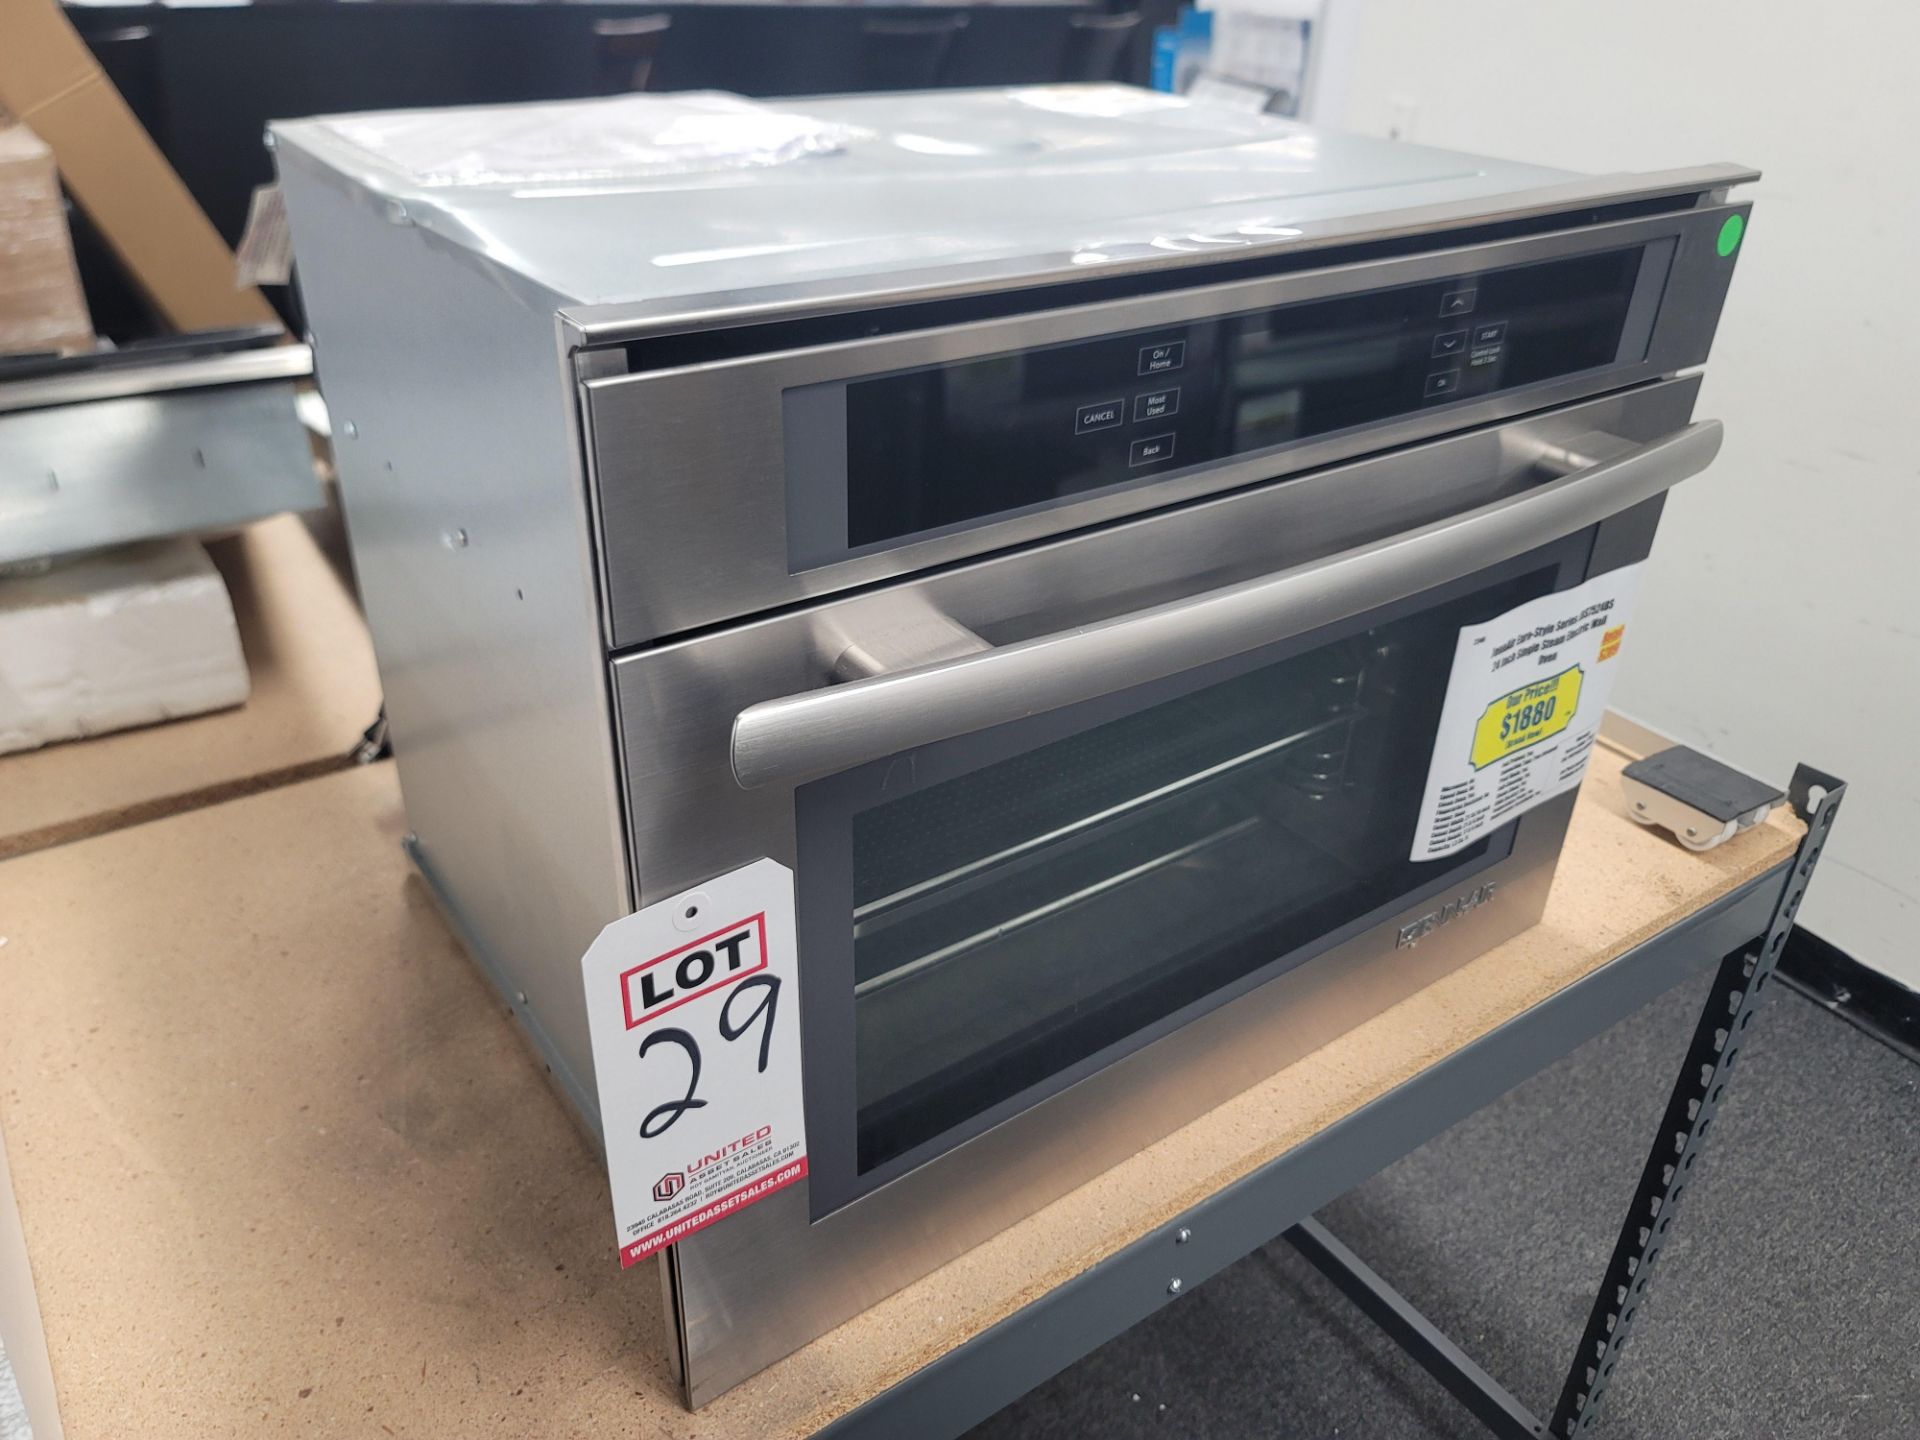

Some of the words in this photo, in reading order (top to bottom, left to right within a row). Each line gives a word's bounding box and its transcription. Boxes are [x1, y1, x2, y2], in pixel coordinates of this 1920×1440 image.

[1149, 359, 1171, 371] Home
[1152, 349, 1165, 360] On
[1146, 405, 1165, 417] Used
[1147, 394, 1167, 406] Most
[1083, 410, 1115, 424] CANCEL
[1142, 445, 1161, 457] Back
[1499, 695, 1557, 740] $1880
[640, 929, 751, 1010] LOT
[638, 973, 783, 1139] 29
[686, 1124, 772, 1174] UNITED
[689, 1160, 729, 1184] ASSET
[732, 1139, 772, 1162] SALES
[646, 1200, 684, 1222] CALABASAS
[704, 1181, 723, 1196] SUITE
[773, 1150, 783, 1162] CA
[629, 1163, 801, 1259] WWW.UNITEDASSETSALES.COM
[632, 1222, 655, 1236] OFFICE
